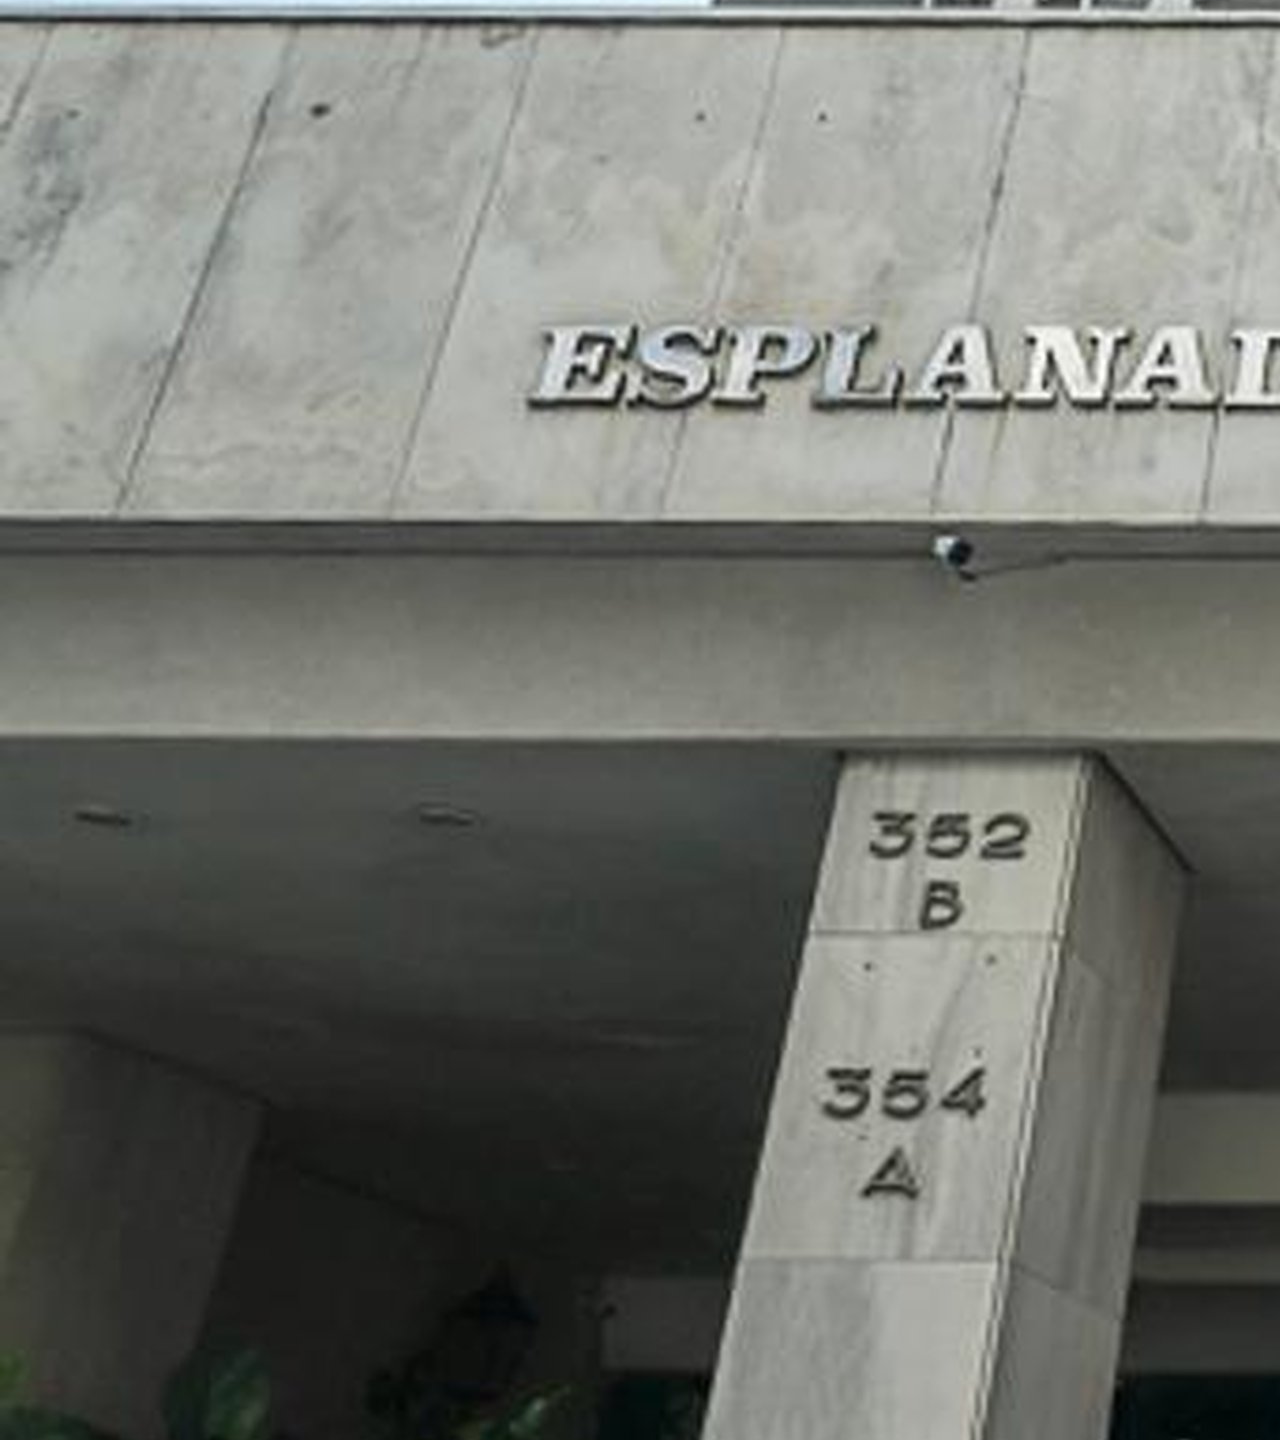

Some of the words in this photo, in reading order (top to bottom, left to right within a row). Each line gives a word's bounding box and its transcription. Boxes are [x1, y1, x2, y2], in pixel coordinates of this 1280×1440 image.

[867, 811, 1031, 860] 352
[918, 880, 965, 931] B
[821, 1066, 988, 1121] 354
[860, 1146, 920, 1199] A
